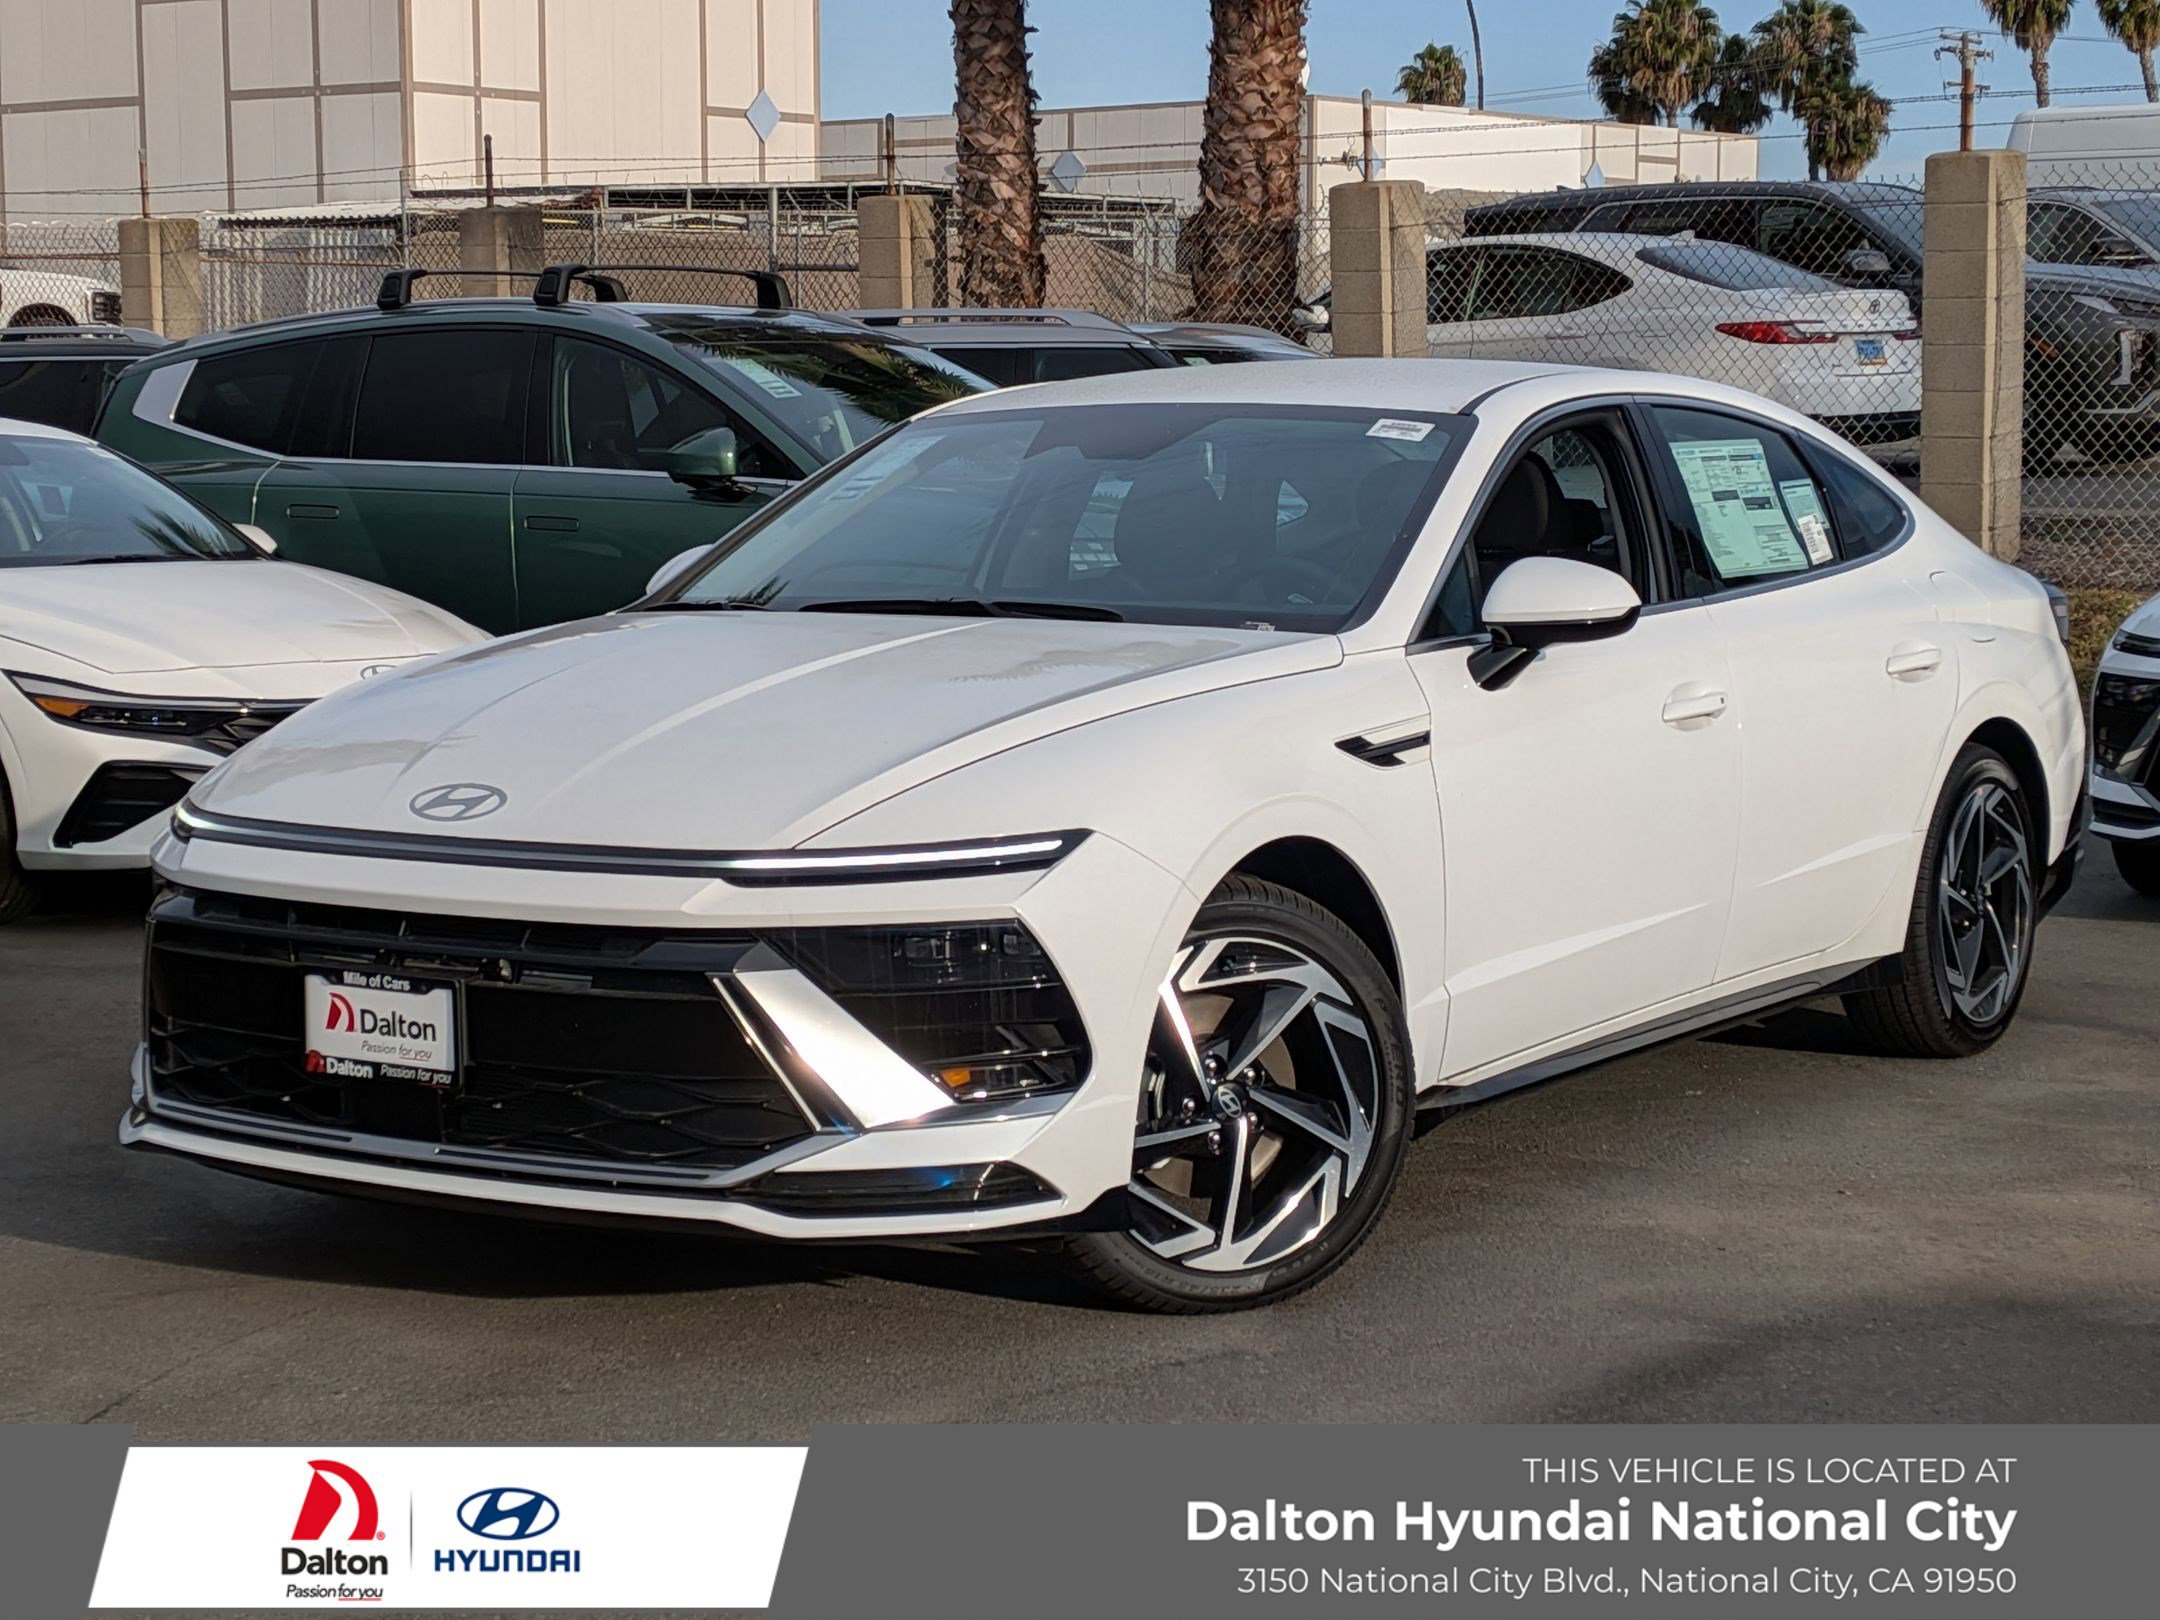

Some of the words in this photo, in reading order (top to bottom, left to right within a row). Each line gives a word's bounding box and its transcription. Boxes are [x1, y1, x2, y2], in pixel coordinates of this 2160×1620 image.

[343, 971, 367, 987] Mile
[368, 975, 381, 988] of
[383, 975, 411, 991] Cars
[359, 1008, 437, 1042] Dalton
[361, 1040, 397, 1055] Passion
[399, 1044, 412, 1058] for
[414, 1048, 432, 1060] you
[326, 1058, 373, 1079] Dalton
[380, 1064, 416, 1080] Passion
[417, 1069, 431, 1082] for
[432, 1073, 452, 1085] you
